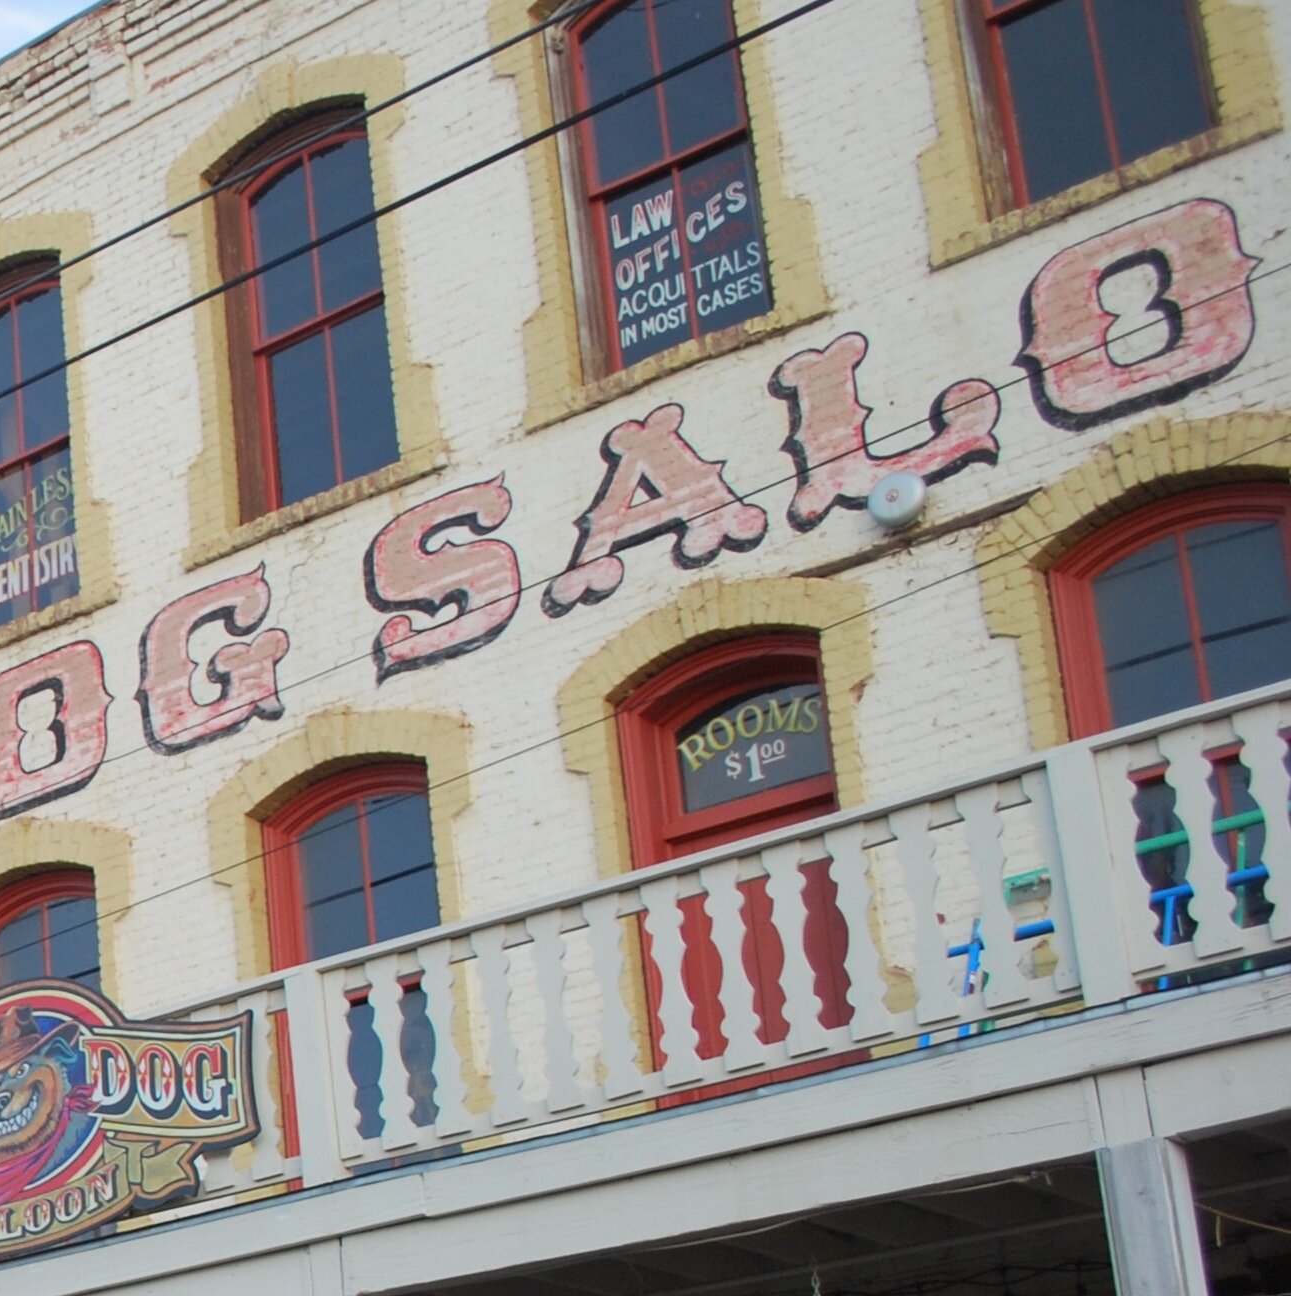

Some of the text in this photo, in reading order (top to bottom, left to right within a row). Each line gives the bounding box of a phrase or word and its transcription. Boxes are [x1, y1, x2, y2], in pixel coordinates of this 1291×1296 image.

[610, 189, 674, 249] LAW
[615, 181, 748, 291] OFFICES
[617, 241, 762, 322] ACQUITTALS
[620, 272, 764, 350] IN MOST CASES
[367, 197, 1262, 668] SALO
[677, 696, 822, 772] ROOMS
[81, 1036, 234, 1121] DOG
